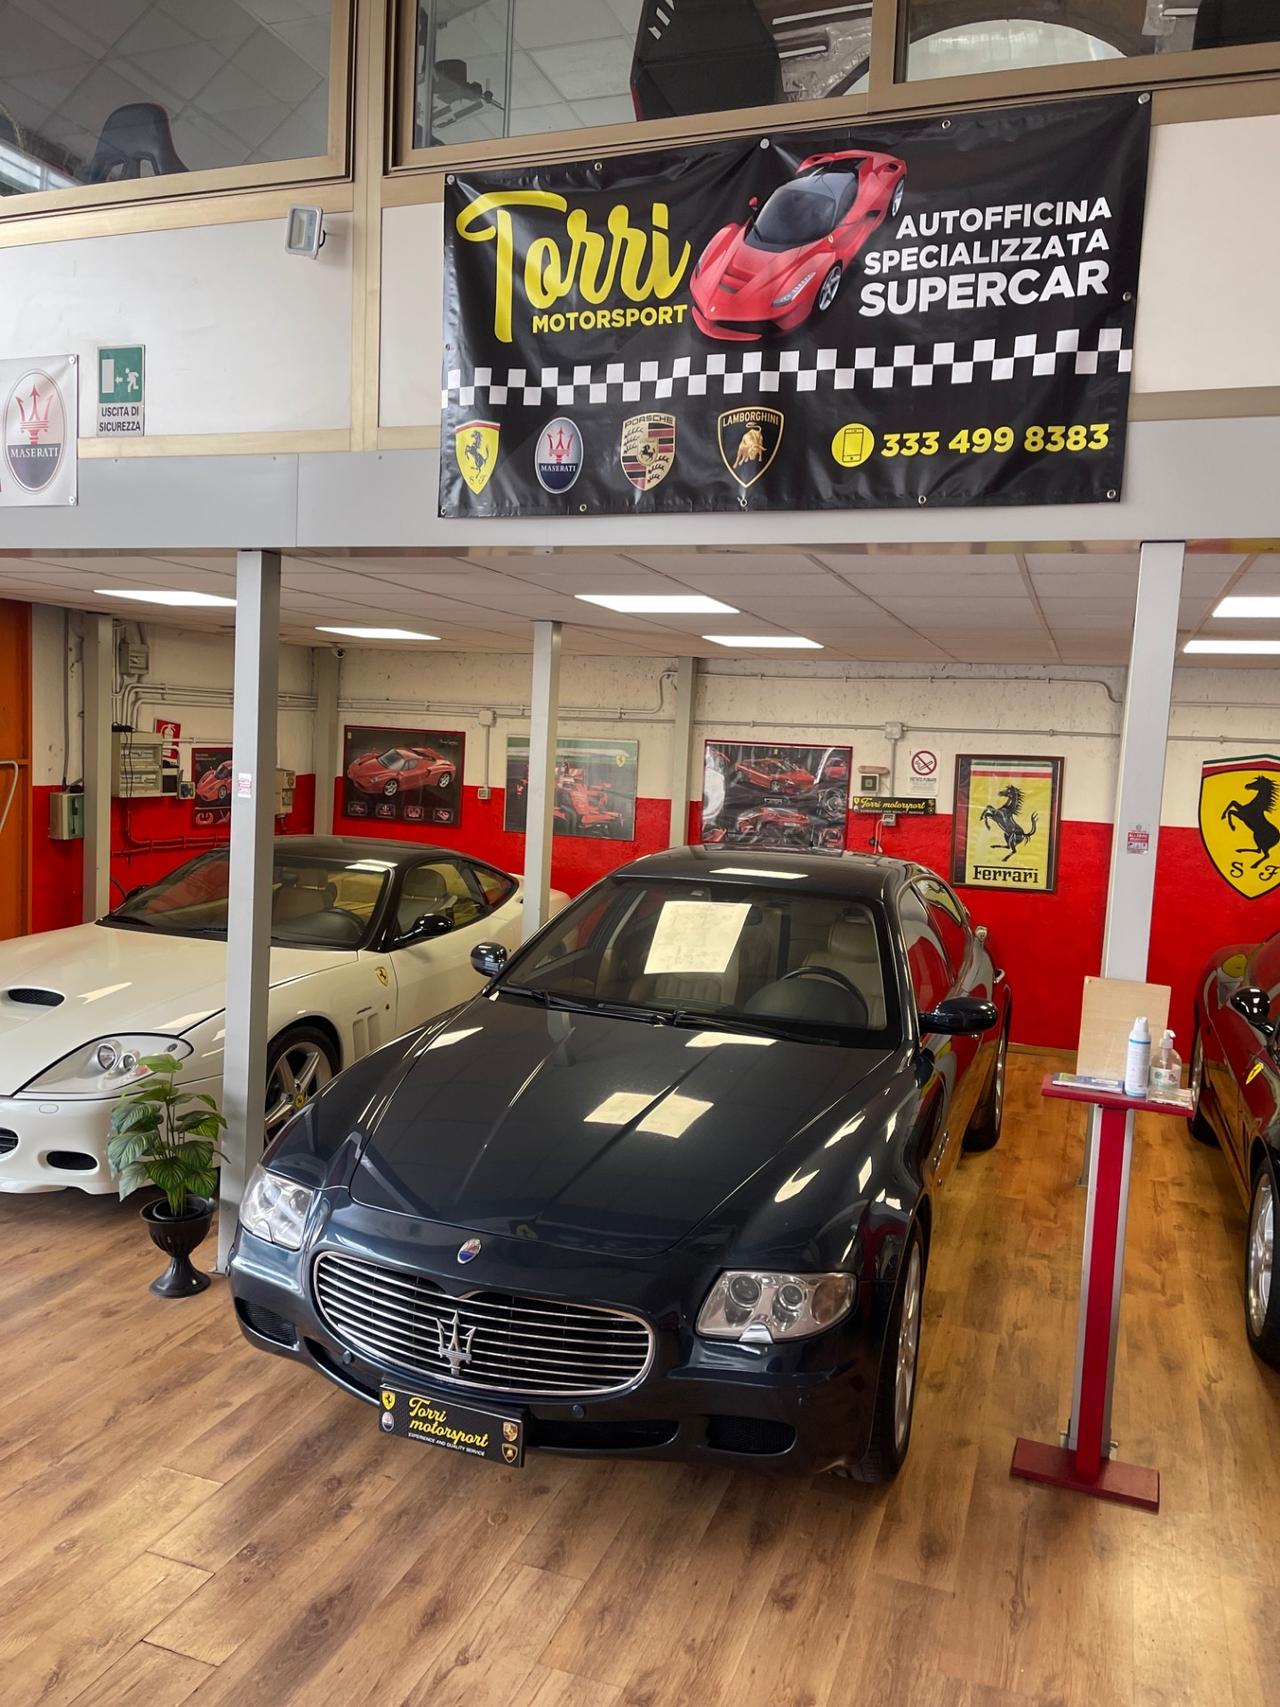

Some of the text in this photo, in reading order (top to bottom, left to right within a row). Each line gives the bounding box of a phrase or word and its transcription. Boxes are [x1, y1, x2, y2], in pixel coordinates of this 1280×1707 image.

[896, 196, 1112, 240] AUTOFFICINA
[863, 228, 1110, 276] SPECIALIZZATA
[456, 190, 691, 343] Torri
[858, 259, 1110, 317] SUPERCAR
[532, 304, 687, 333] MOTORSPORT
[101, 405, 139, 418] USCITA DI
[624, 414, 674, 428] PORSCHE
[722, 411, 779, 427] LAMBORGHINI
[99, 421, 141, 433] SICUREZZA
[881, 423, 1110, 457] 333 499 8383
[11, 448, 58, 458] MASERATI
[972, 865, 1039, 884] Ferrari
[1230, 861, 1244, 878] S
[408, 1397, 447, 1422] Torri
[409, 1420, 489, 1447] motorsport
